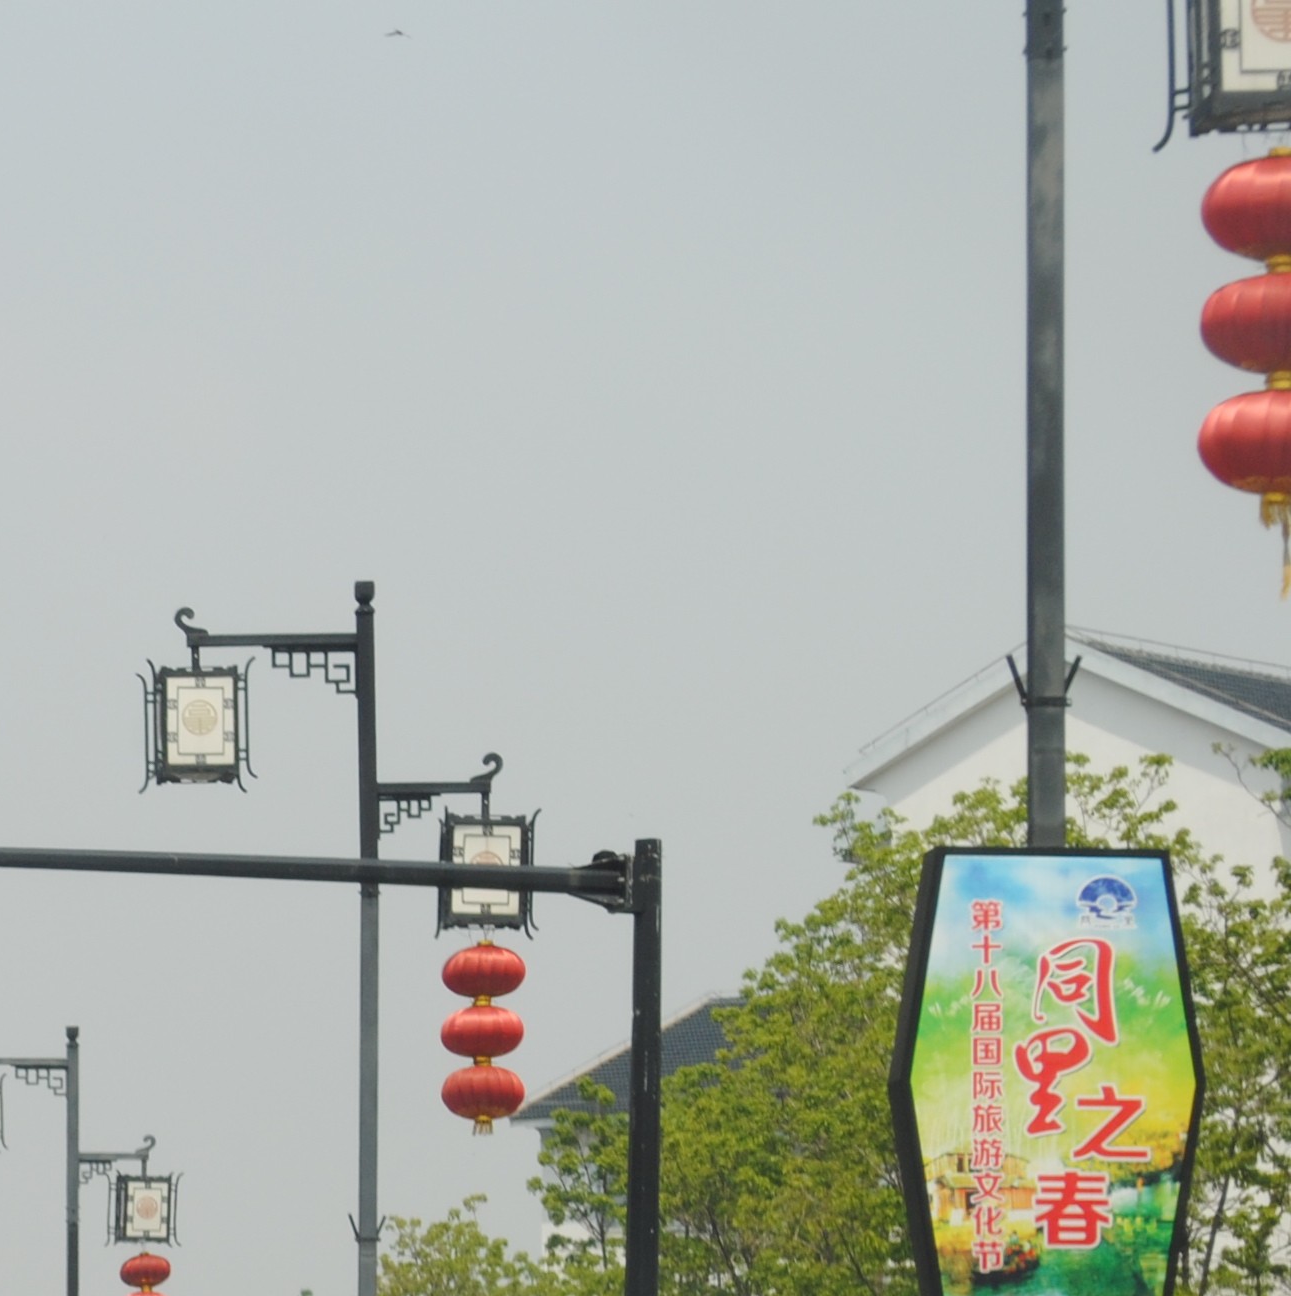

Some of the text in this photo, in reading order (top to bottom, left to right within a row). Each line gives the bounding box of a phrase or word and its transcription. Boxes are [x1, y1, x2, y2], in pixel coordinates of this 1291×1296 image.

[970, 900, 1004, 1274] 第十八届国际旅游文化节
